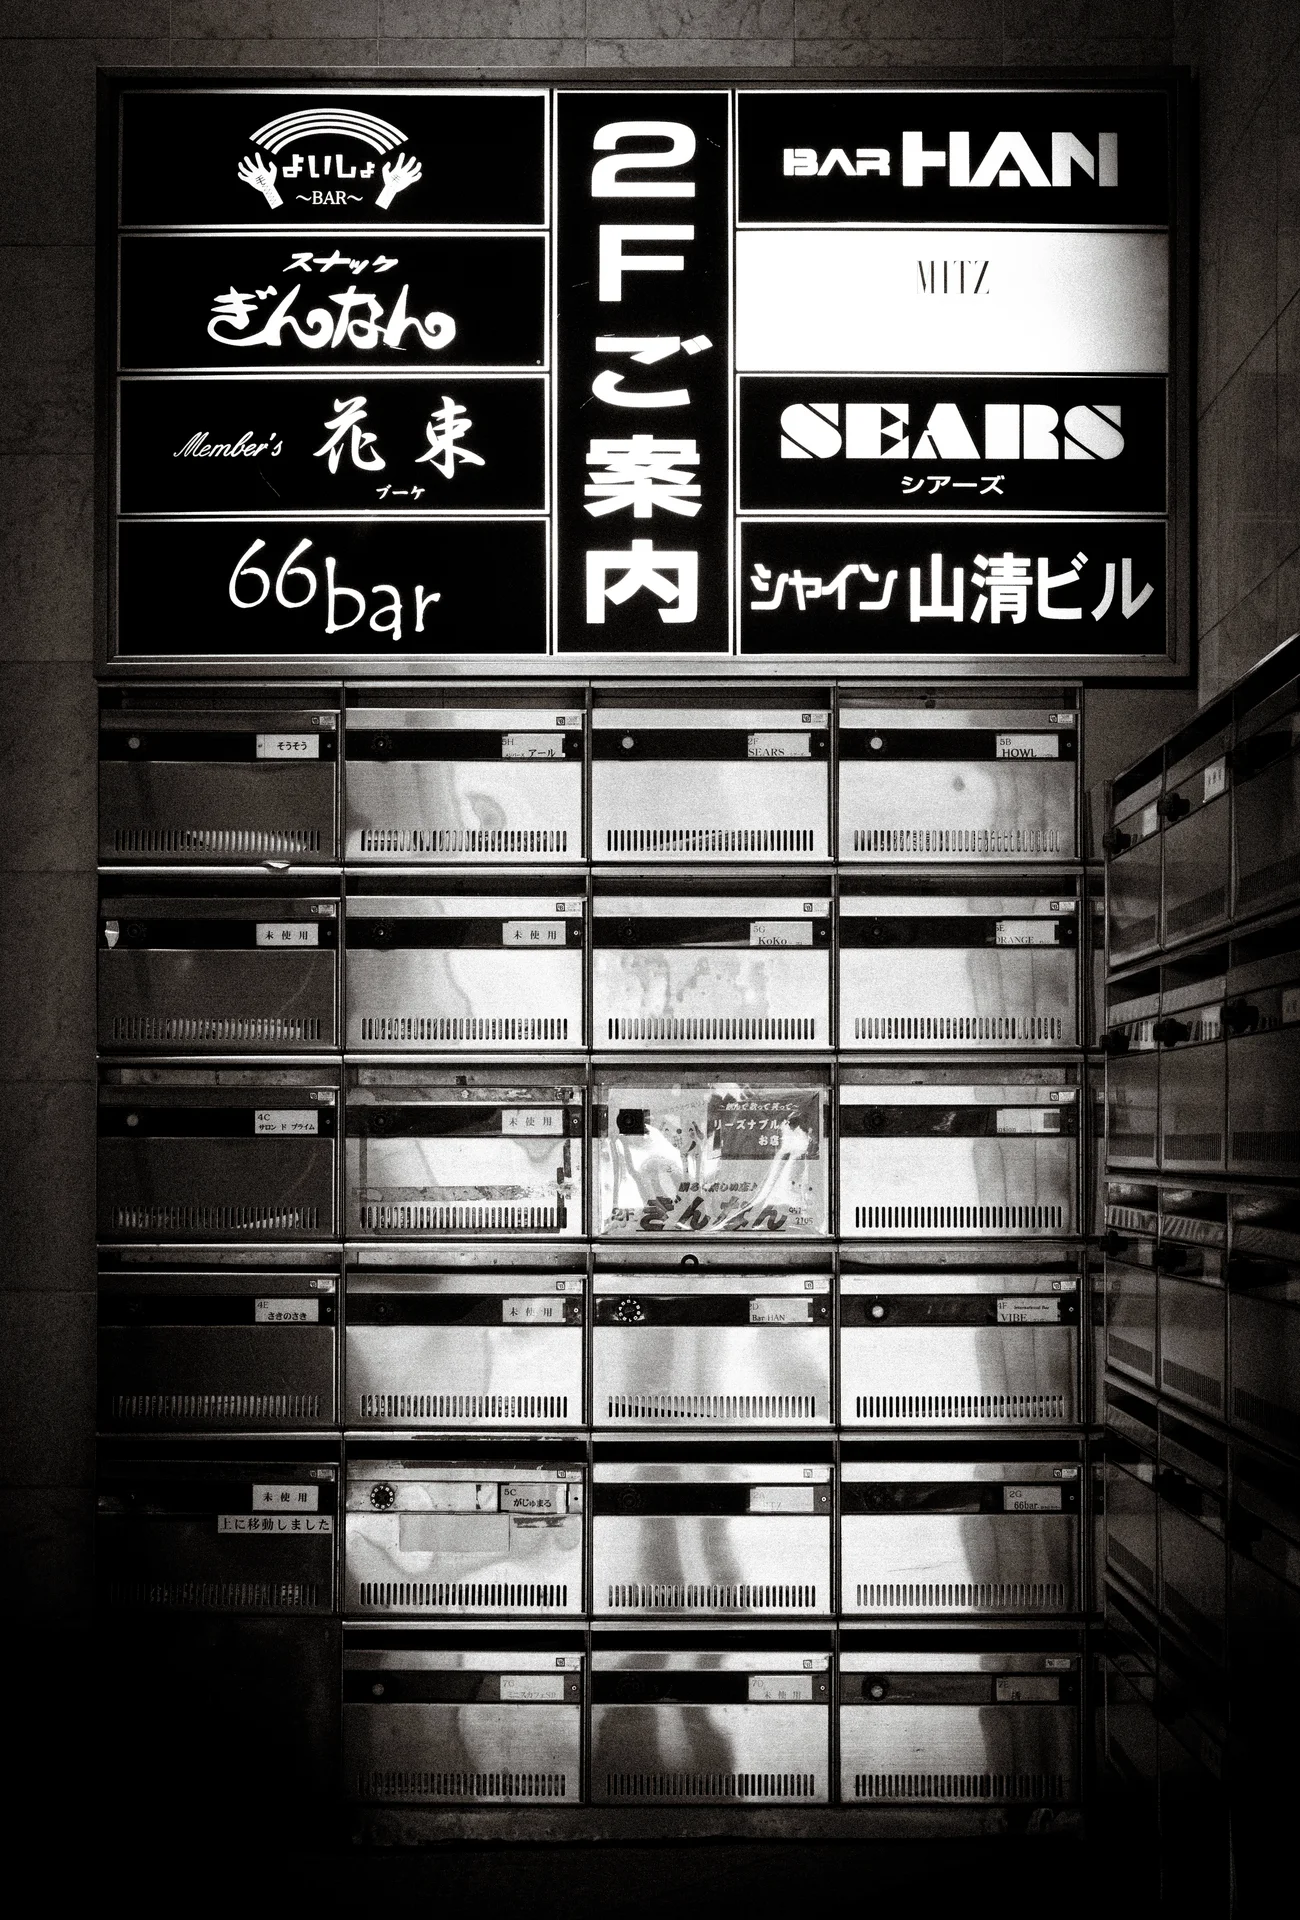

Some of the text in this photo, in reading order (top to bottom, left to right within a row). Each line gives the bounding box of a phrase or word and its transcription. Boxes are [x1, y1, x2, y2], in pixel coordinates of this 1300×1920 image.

[783, 130, 1118, 188] BAR HAN
[282, 153, 376, 179] よいしょ
[282, 249, 399, 275] スナック
[916, 260, 990, 296] MITZ
[206, 283, 457, 351] ぎんなん
[780, 402, 1125, 460] SEARS
[173, 430, 284, 459] Member's
[900, 474, 1006, 495] シアーズ
[375, 483, 426, 500] ブーケ
[228, 537, 441, 642] 66bar
[750, 551, 1155, 625] シャイン 山清ビル
[277, 741, 308, 751] そうそう
[1000, 738, 1012, 746] 5B
[528, 748, 556, 758] アール
[748, 748, 785, 757] SEARS
[1002, 748, 1037, 758] HOWL
[265, 930, 308, 941] 未使用
[513, 930, 557, 940] 未使用
[758, 936, 787, 946] KoKo
[257, 1113, 270, 1121] 4C
[510, 1116, 552, 1127] 未使用
[257, 1301, 269, 1309] 4E
[267, 1311, 307, 1321] さきのさき
[752, 1314, 785, 1322] Bar HAN
[1001, 1313, 1027, 1322] VIBE
[263, 1491, 307, 1502] 未使用
[504, 1488, 517, 1496] 5C
[1009, 1490, 1022, 1498] 2G
[513, 1497, 552, 1508] がじゅまる
[223, 1517, 330, 1531] 上に移動しました
